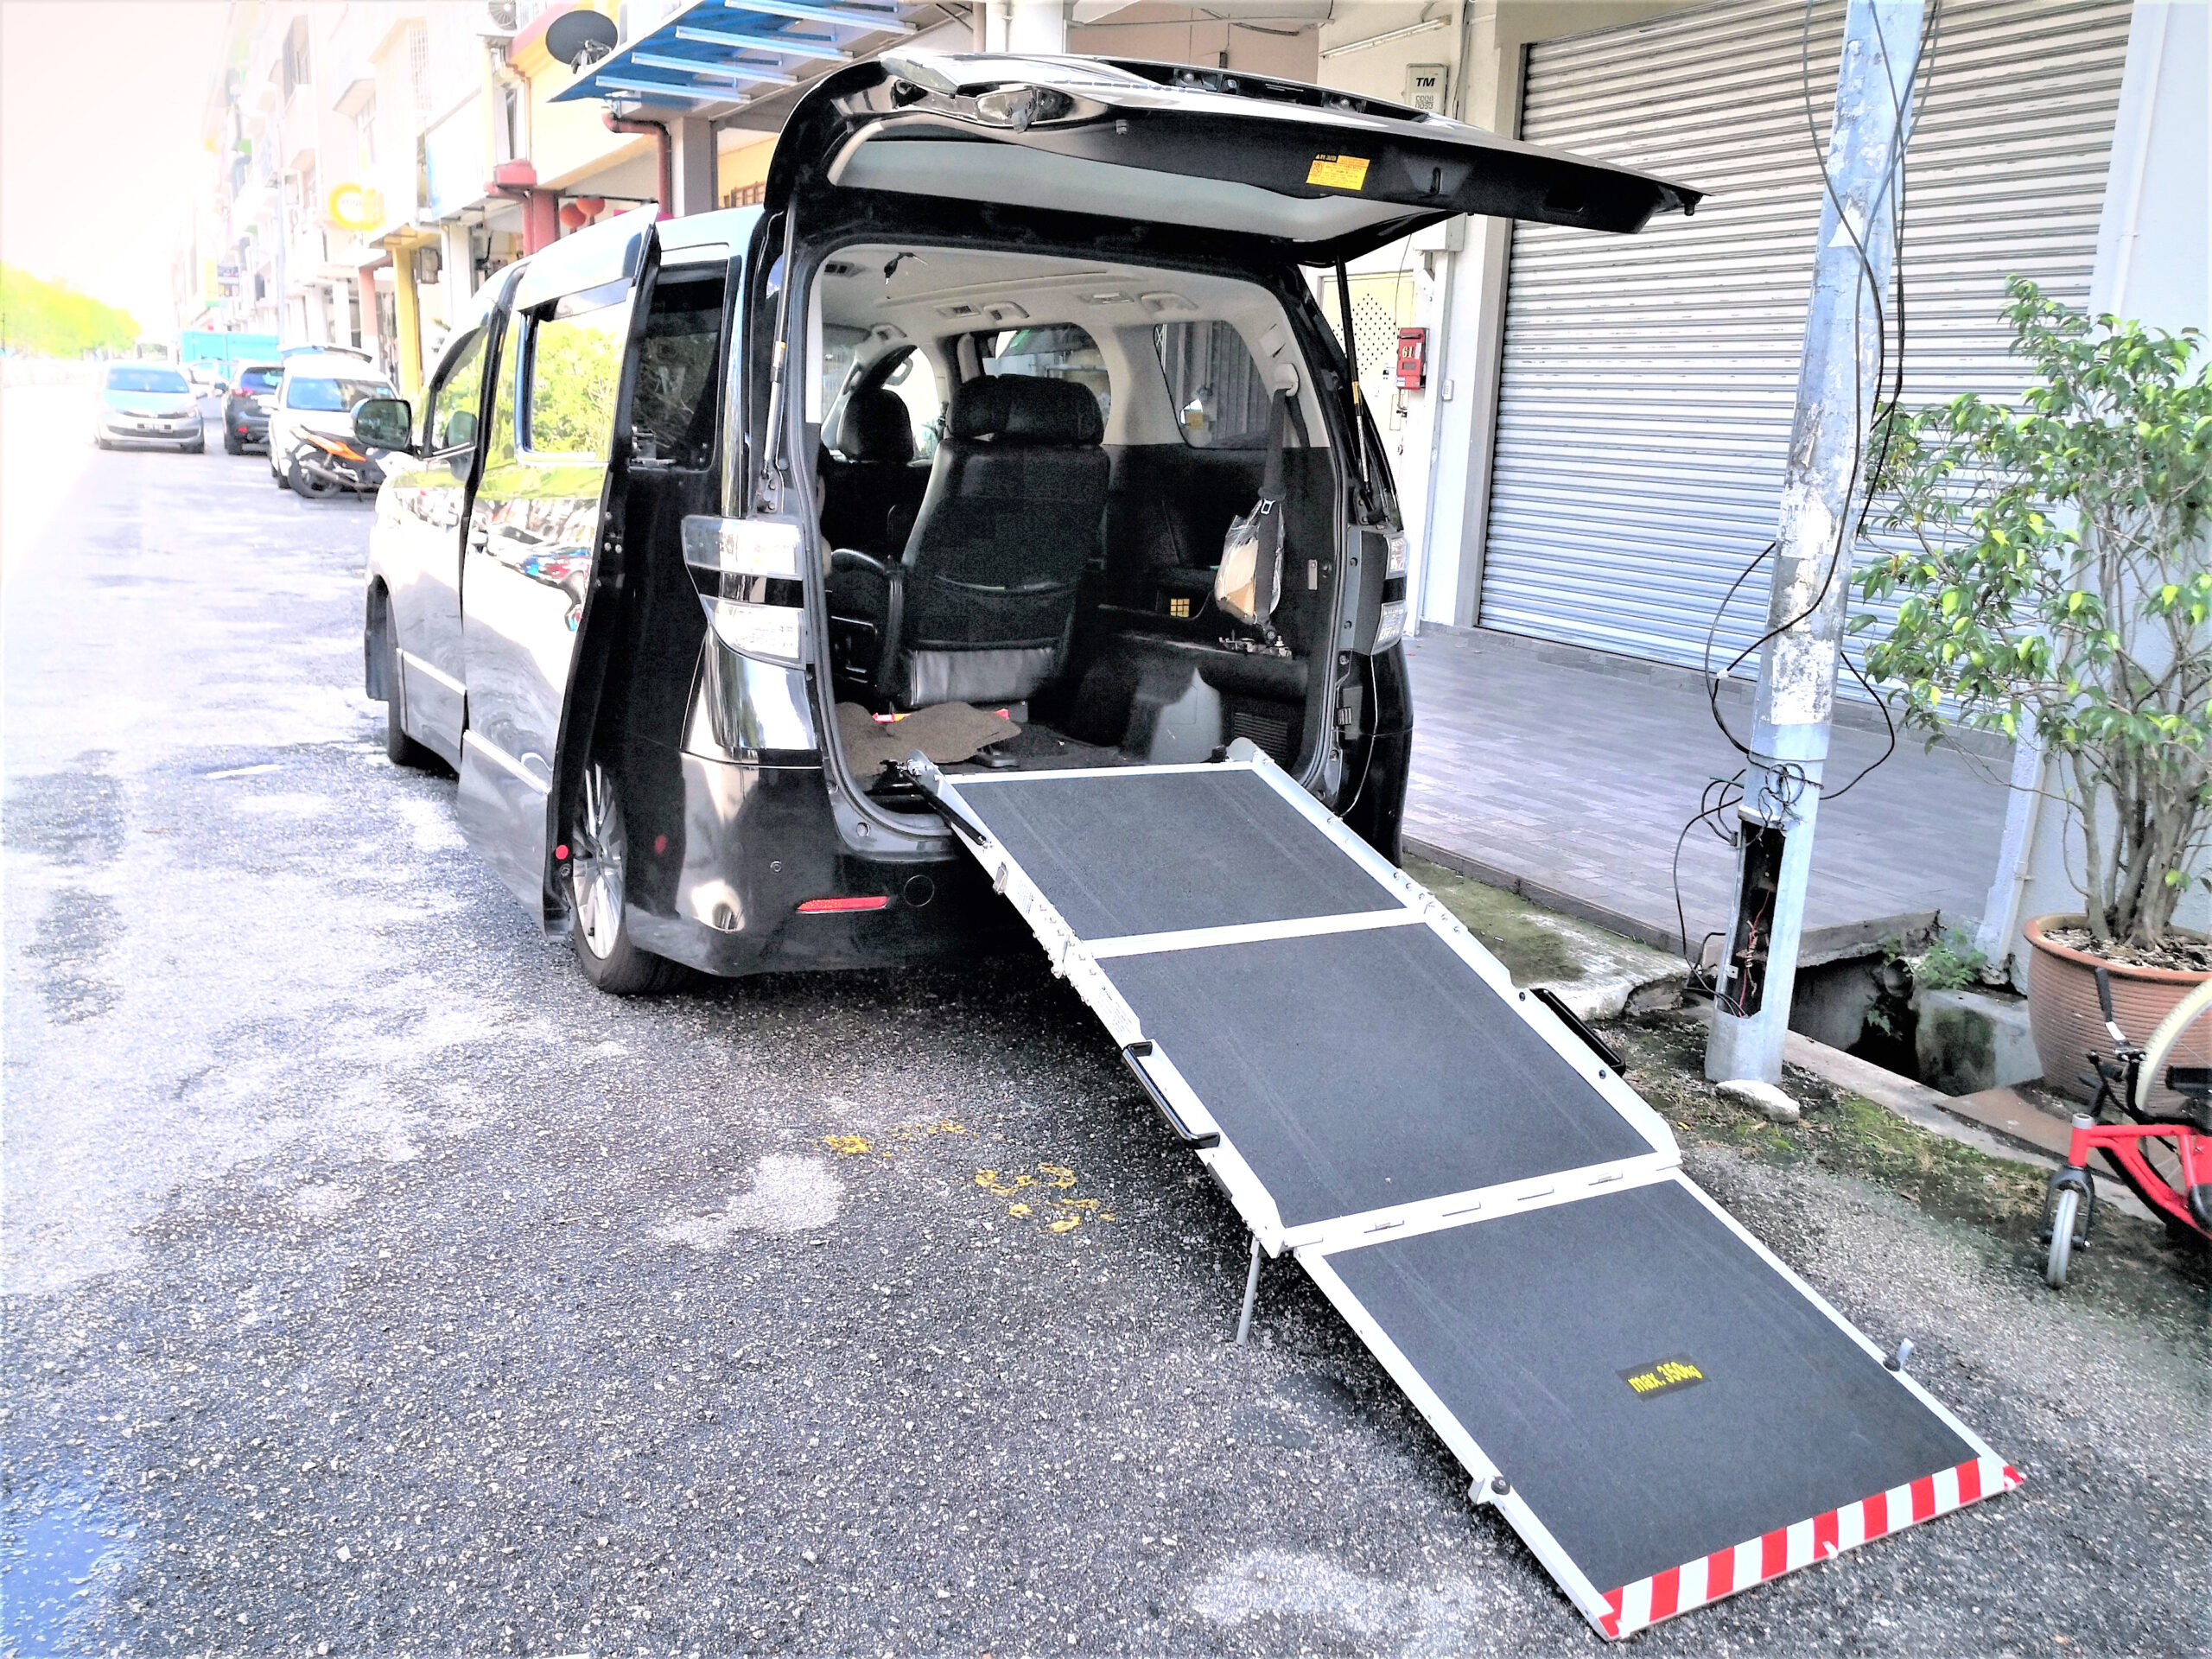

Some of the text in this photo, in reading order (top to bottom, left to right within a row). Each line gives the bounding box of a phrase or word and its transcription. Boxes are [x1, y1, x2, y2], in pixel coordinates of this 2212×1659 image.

[1416, 77, 1435, 87] TM
[1402, 346, 1414, 359] 61
[1627, 1361, 1703, 1393] max. 350kg
